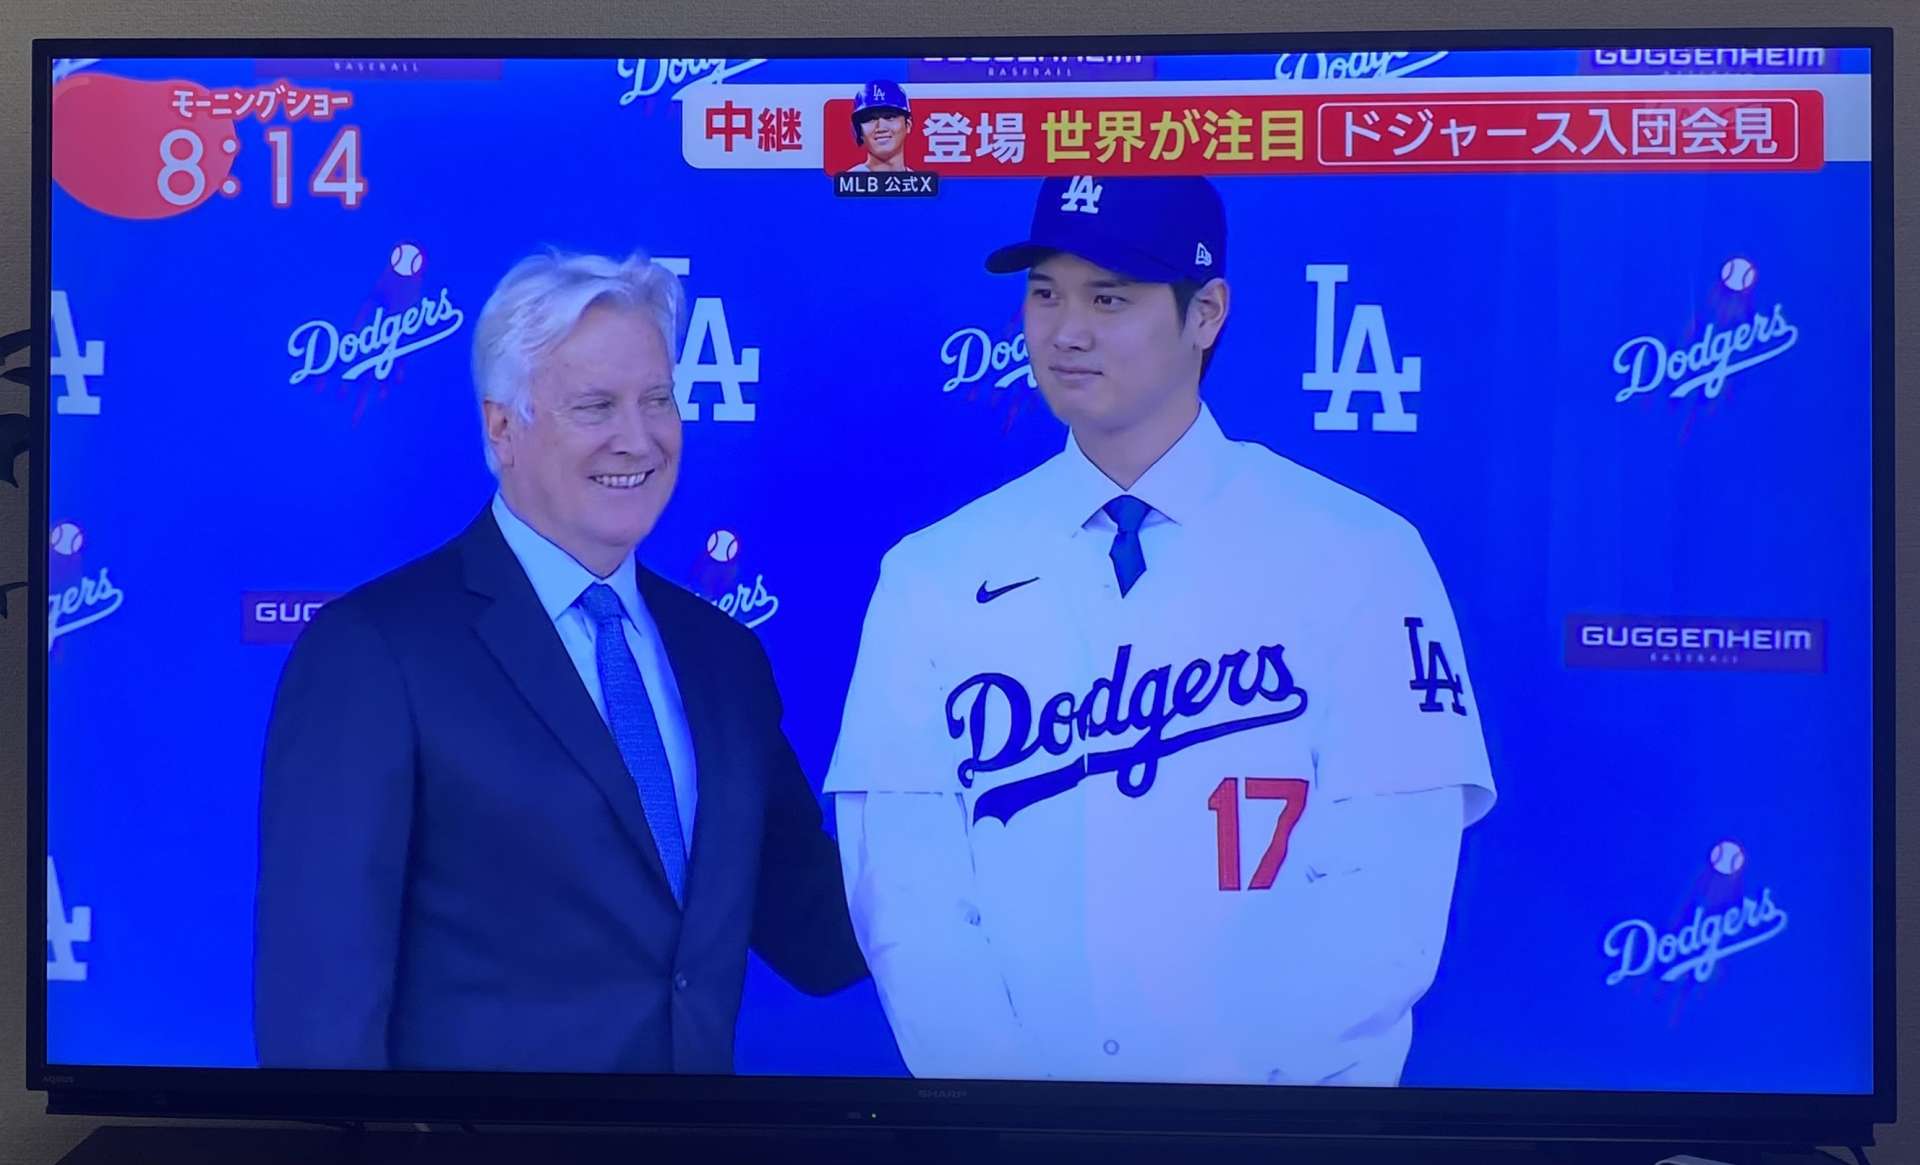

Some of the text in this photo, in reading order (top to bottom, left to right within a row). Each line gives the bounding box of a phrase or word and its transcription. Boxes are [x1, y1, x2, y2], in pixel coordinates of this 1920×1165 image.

[172, 84, 349, 118] モーニングショー
[1594, 48, 1826, 66] GUGGENHEIM
[156, 128, 364, 206] 8:14
[704, 99, 803, 153] 中継
[922, 106, 1779, 164] 登場 世界が注目 ドジャース入団会見
[839, 175, 932, 193] MLB 公式X
[288, 288, 464, 386] Dodgers
[1302, 264, 1422, 433] LA
[1613, 304, 1798, 403] Dodgers
[1404, 617, 1468, 716] LA
[1581, 625, 1813, 650] GUGGENHEIM
[945, 644, 1309, 826] Dodgers
[1208, 776, 1310, 892] 17
[1603, 888, 1789, 986] Dodgers
